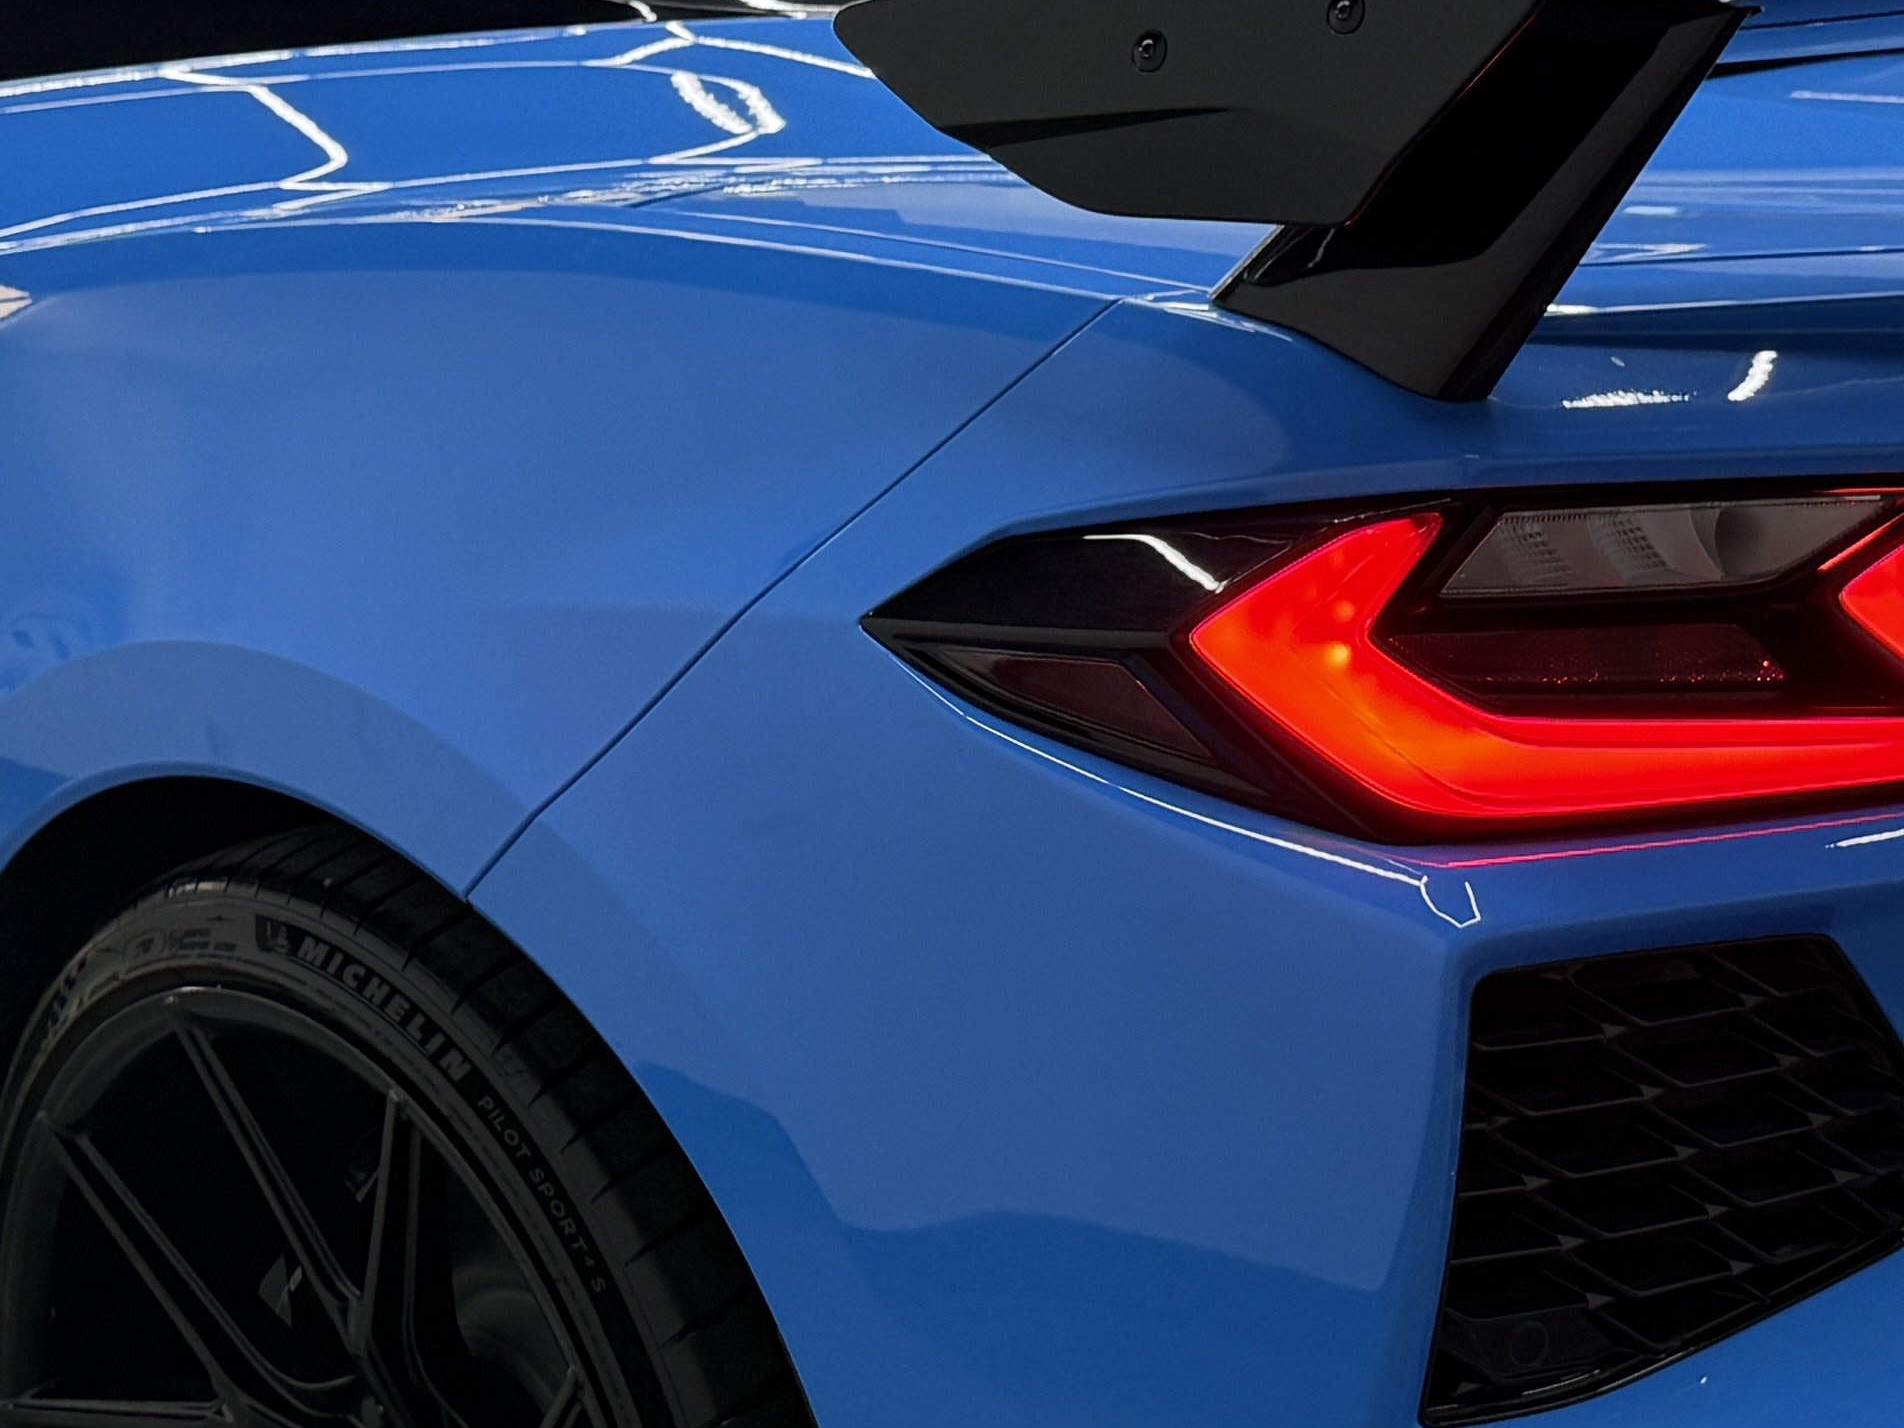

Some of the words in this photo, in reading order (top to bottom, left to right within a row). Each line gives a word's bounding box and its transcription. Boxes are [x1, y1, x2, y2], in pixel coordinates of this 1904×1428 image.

[298, 936, 472, 1084] MICHELIN
[477, 1096, 532, 1158] PILOT
[530, 1169, 589, 1250] SPORT
